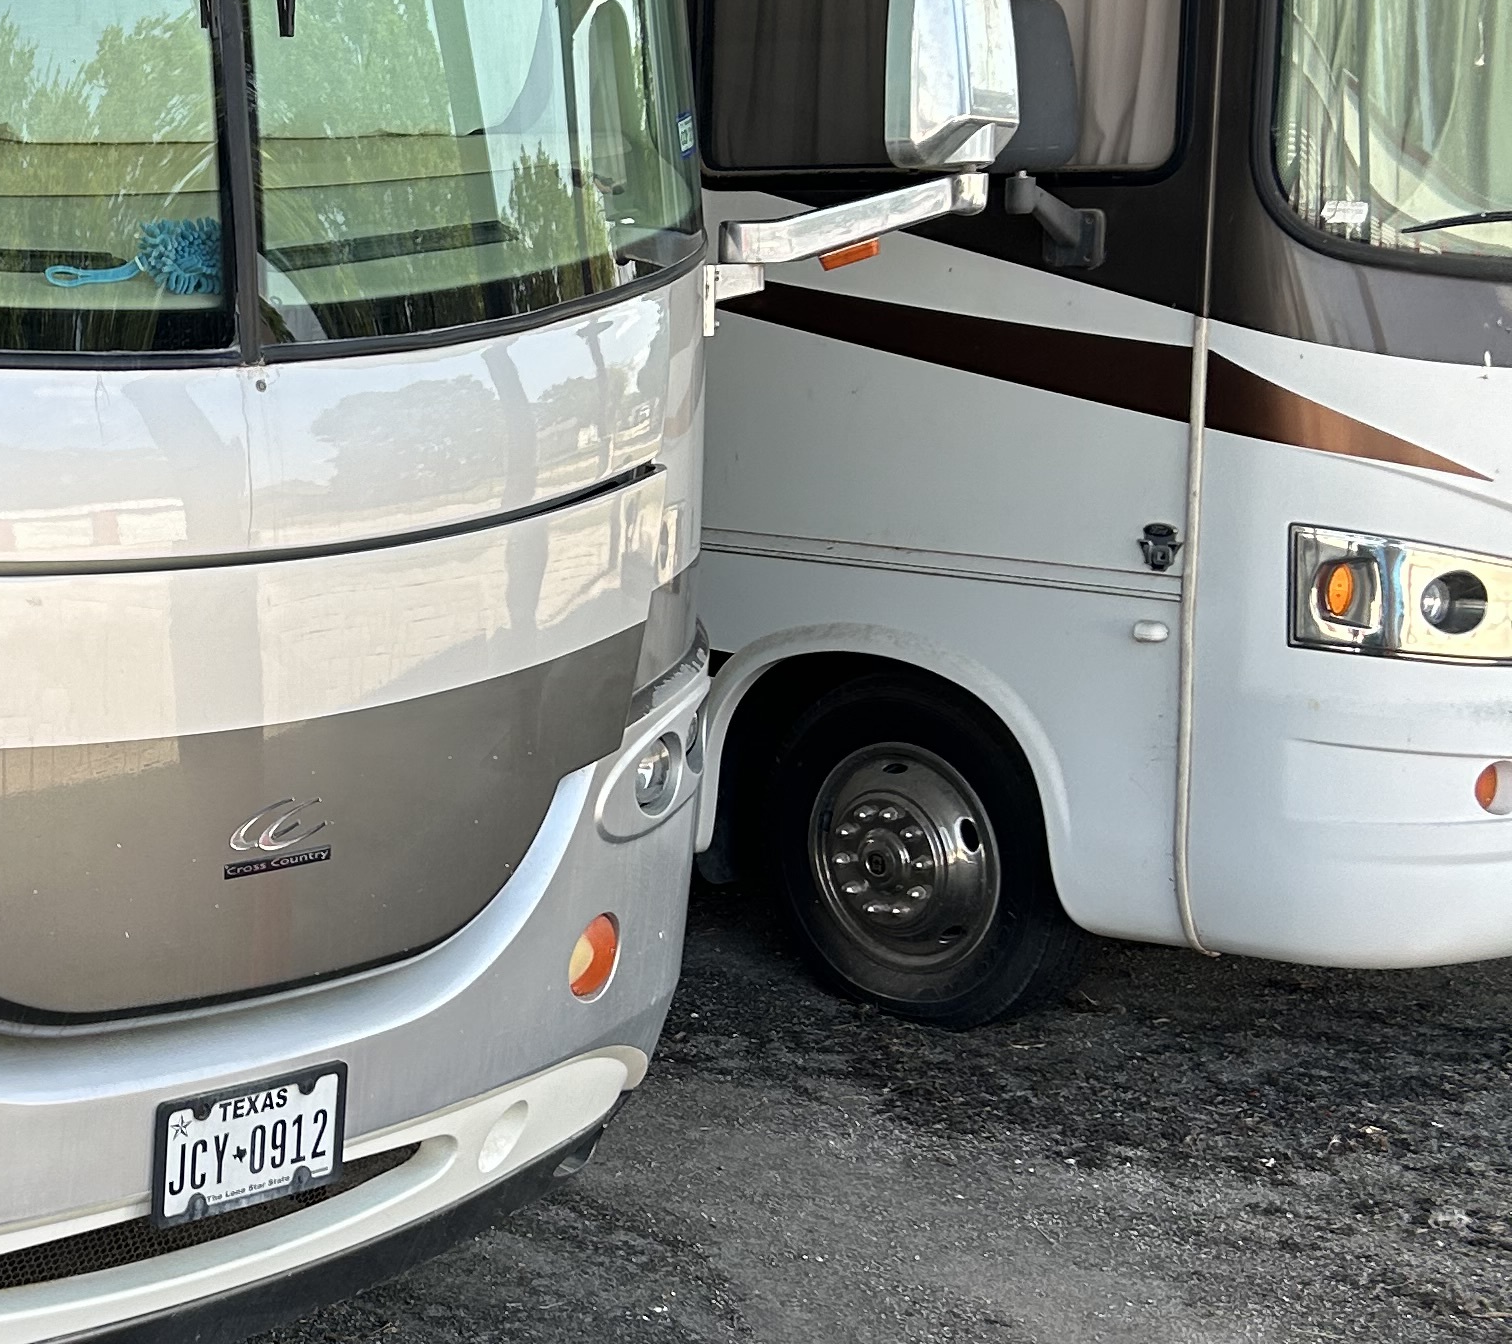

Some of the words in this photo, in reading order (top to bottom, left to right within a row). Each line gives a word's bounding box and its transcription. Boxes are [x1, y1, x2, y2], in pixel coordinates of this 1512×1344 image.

[226, 862, 267, 876] Cross
[271, 849, 329, 867] Country
[219, 1088, 288, 1122] TEXAS
[207, 1194, 222, 1203] The
[225, 1187, 246, 1197] Lone
[249, 1181, 266, 1191] Star
[268, 1175, 290, 1186] State
